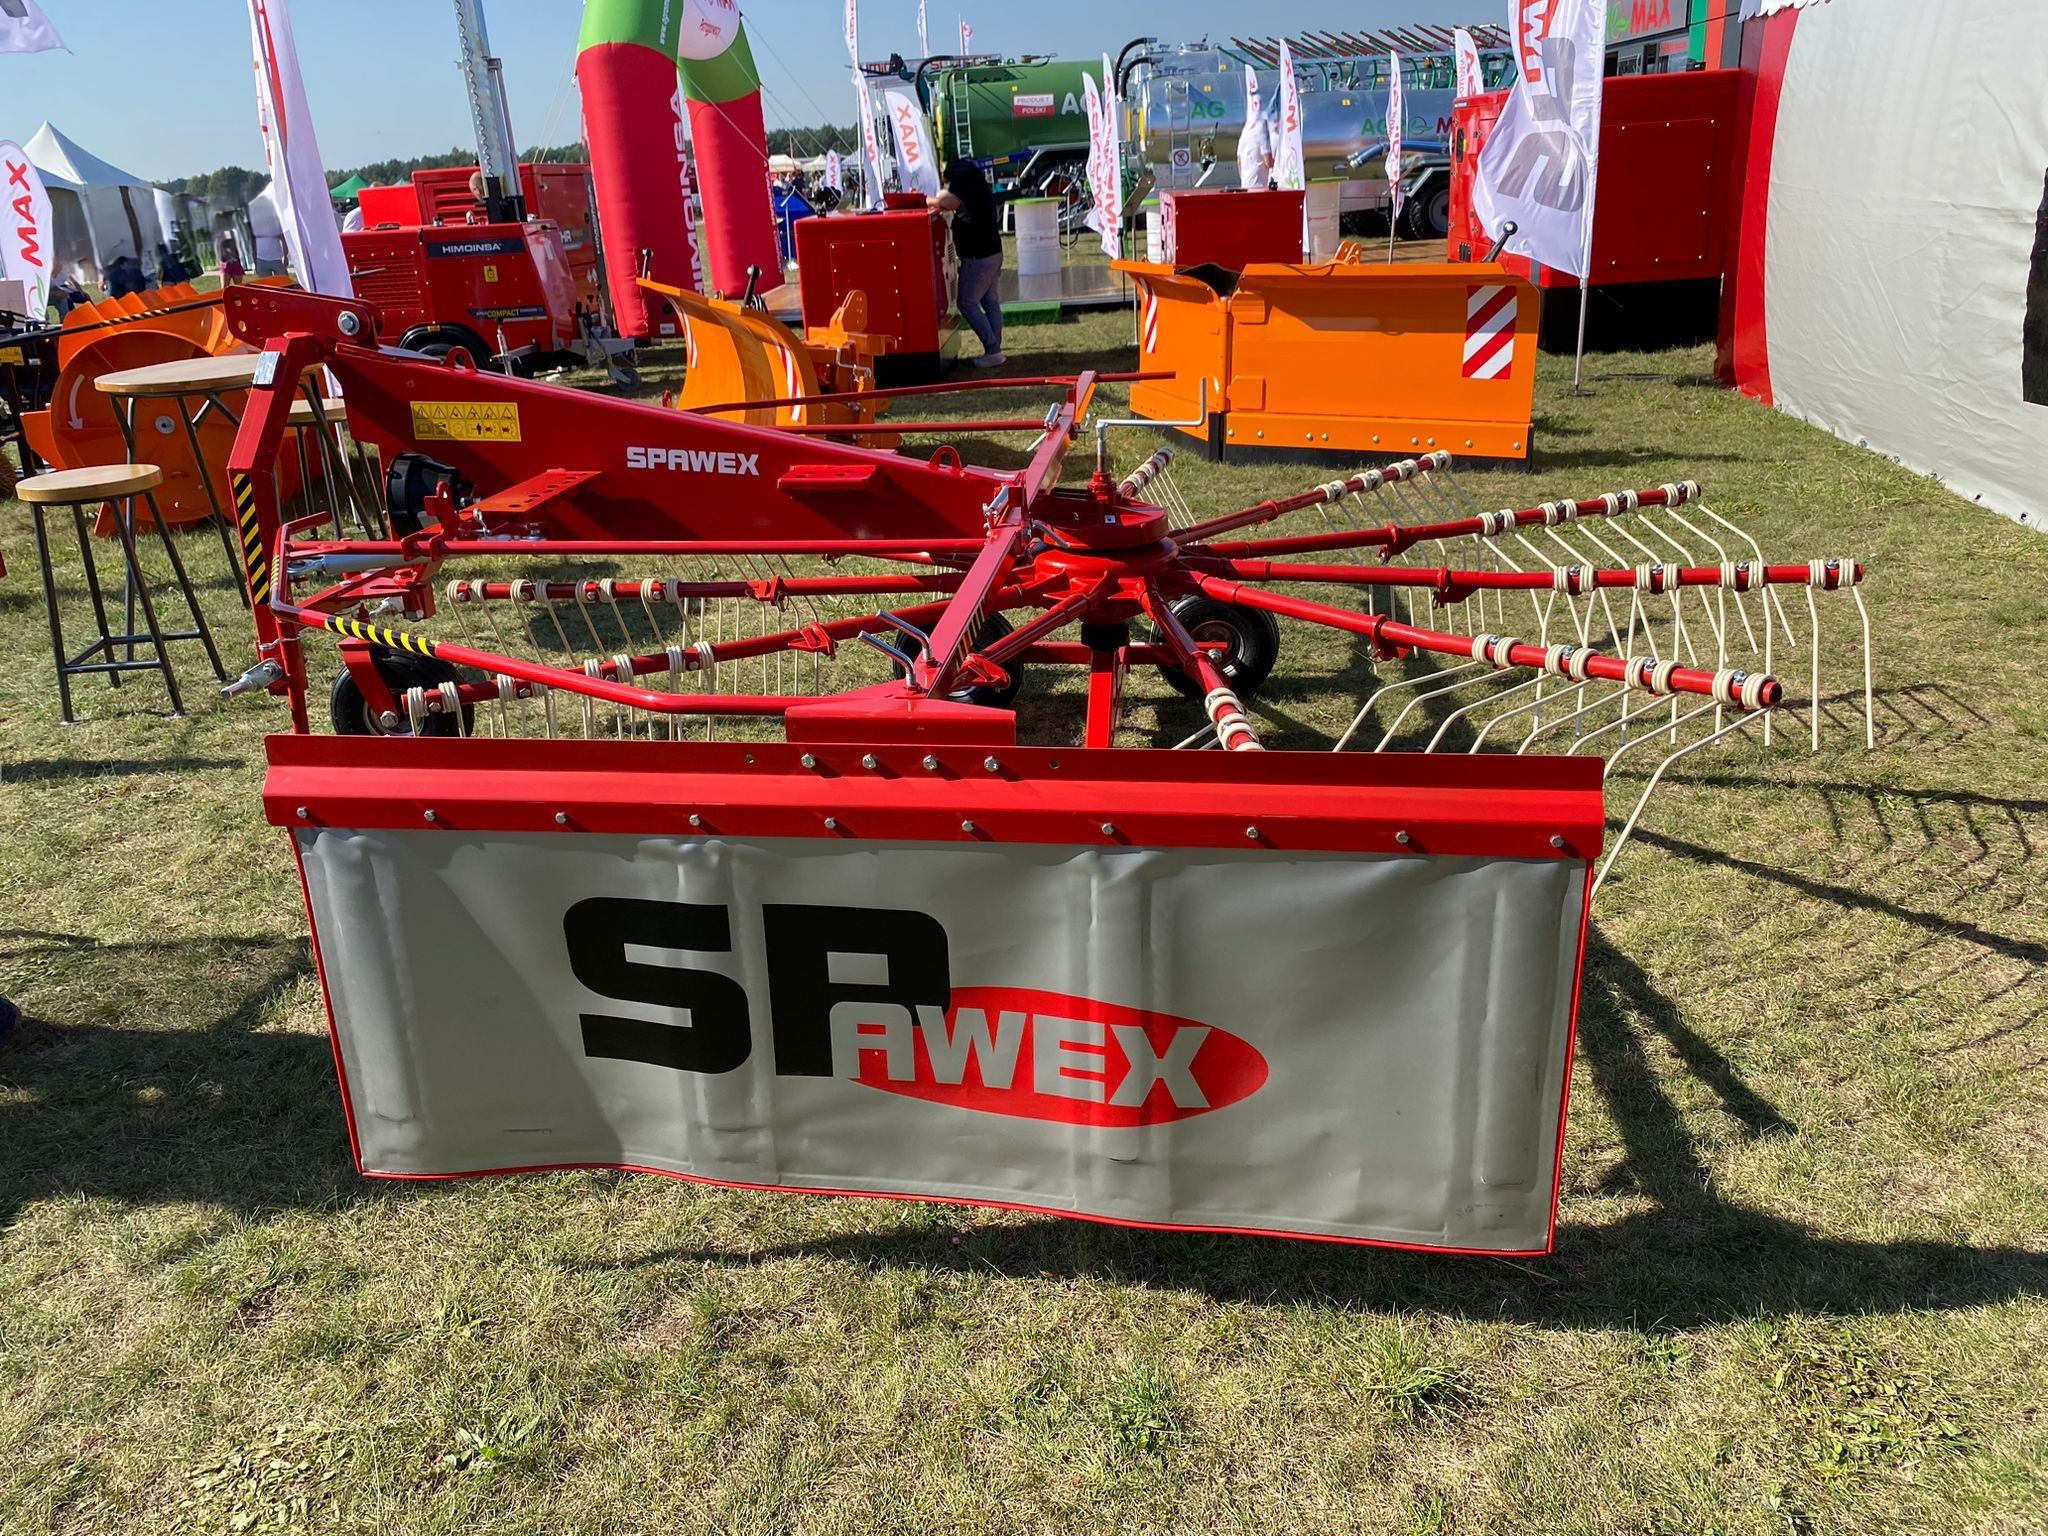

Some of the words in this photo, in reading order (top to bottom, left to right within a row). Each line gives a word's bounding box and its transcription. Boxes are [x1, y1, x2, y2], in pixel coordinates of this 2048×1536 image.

[1016, 96, 1050, 105] PRODUKT
[1022, 107, 1047, 115] POLSKI
[5, 159, 44, 267] MAX
[442, 243, 502, 254] HIMOINSA
[486, 308, 520, 318] COMPACT
[626, 446, 760, 476] SPAWEX
[563, 896, 1212, 1109] SPAWEX
